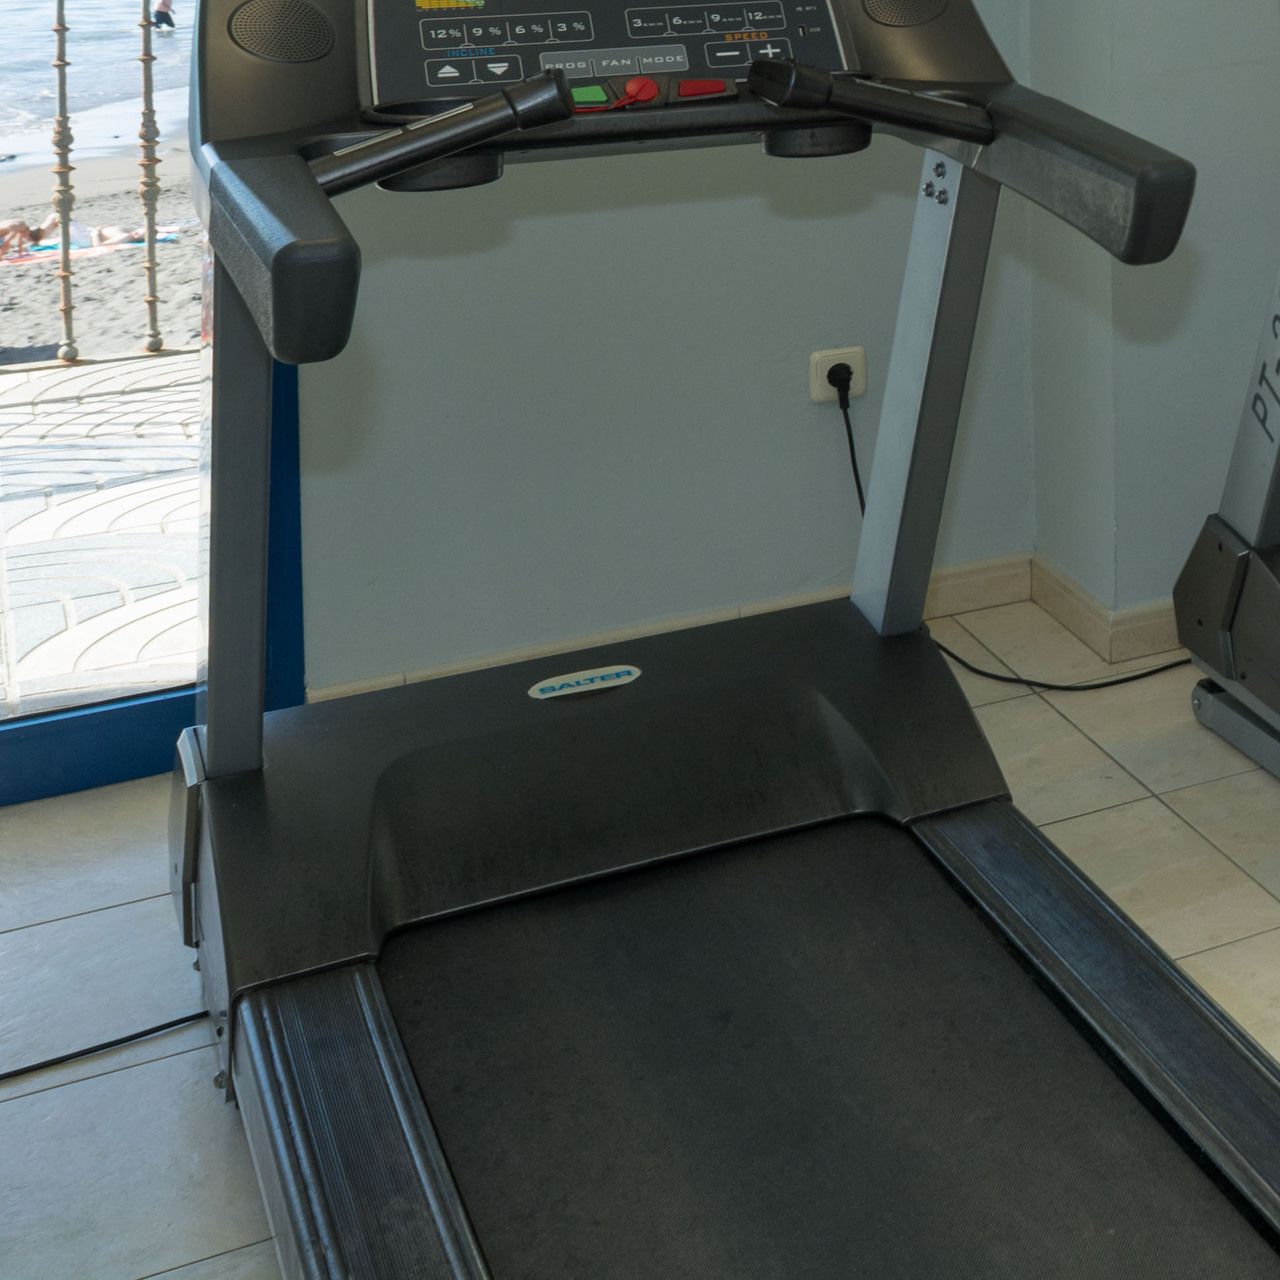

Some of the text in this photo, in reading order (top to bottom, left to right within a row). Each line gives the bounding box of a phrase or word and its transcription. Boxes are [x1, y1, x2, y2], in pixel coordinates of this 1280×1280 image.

[724, 32, 768, 42] SPEED
[447, 47, 496, 57] INCLINE
[545, 56, 685, 71] PROG FAN MODE
[538, 669, 633, 695] SALTER
